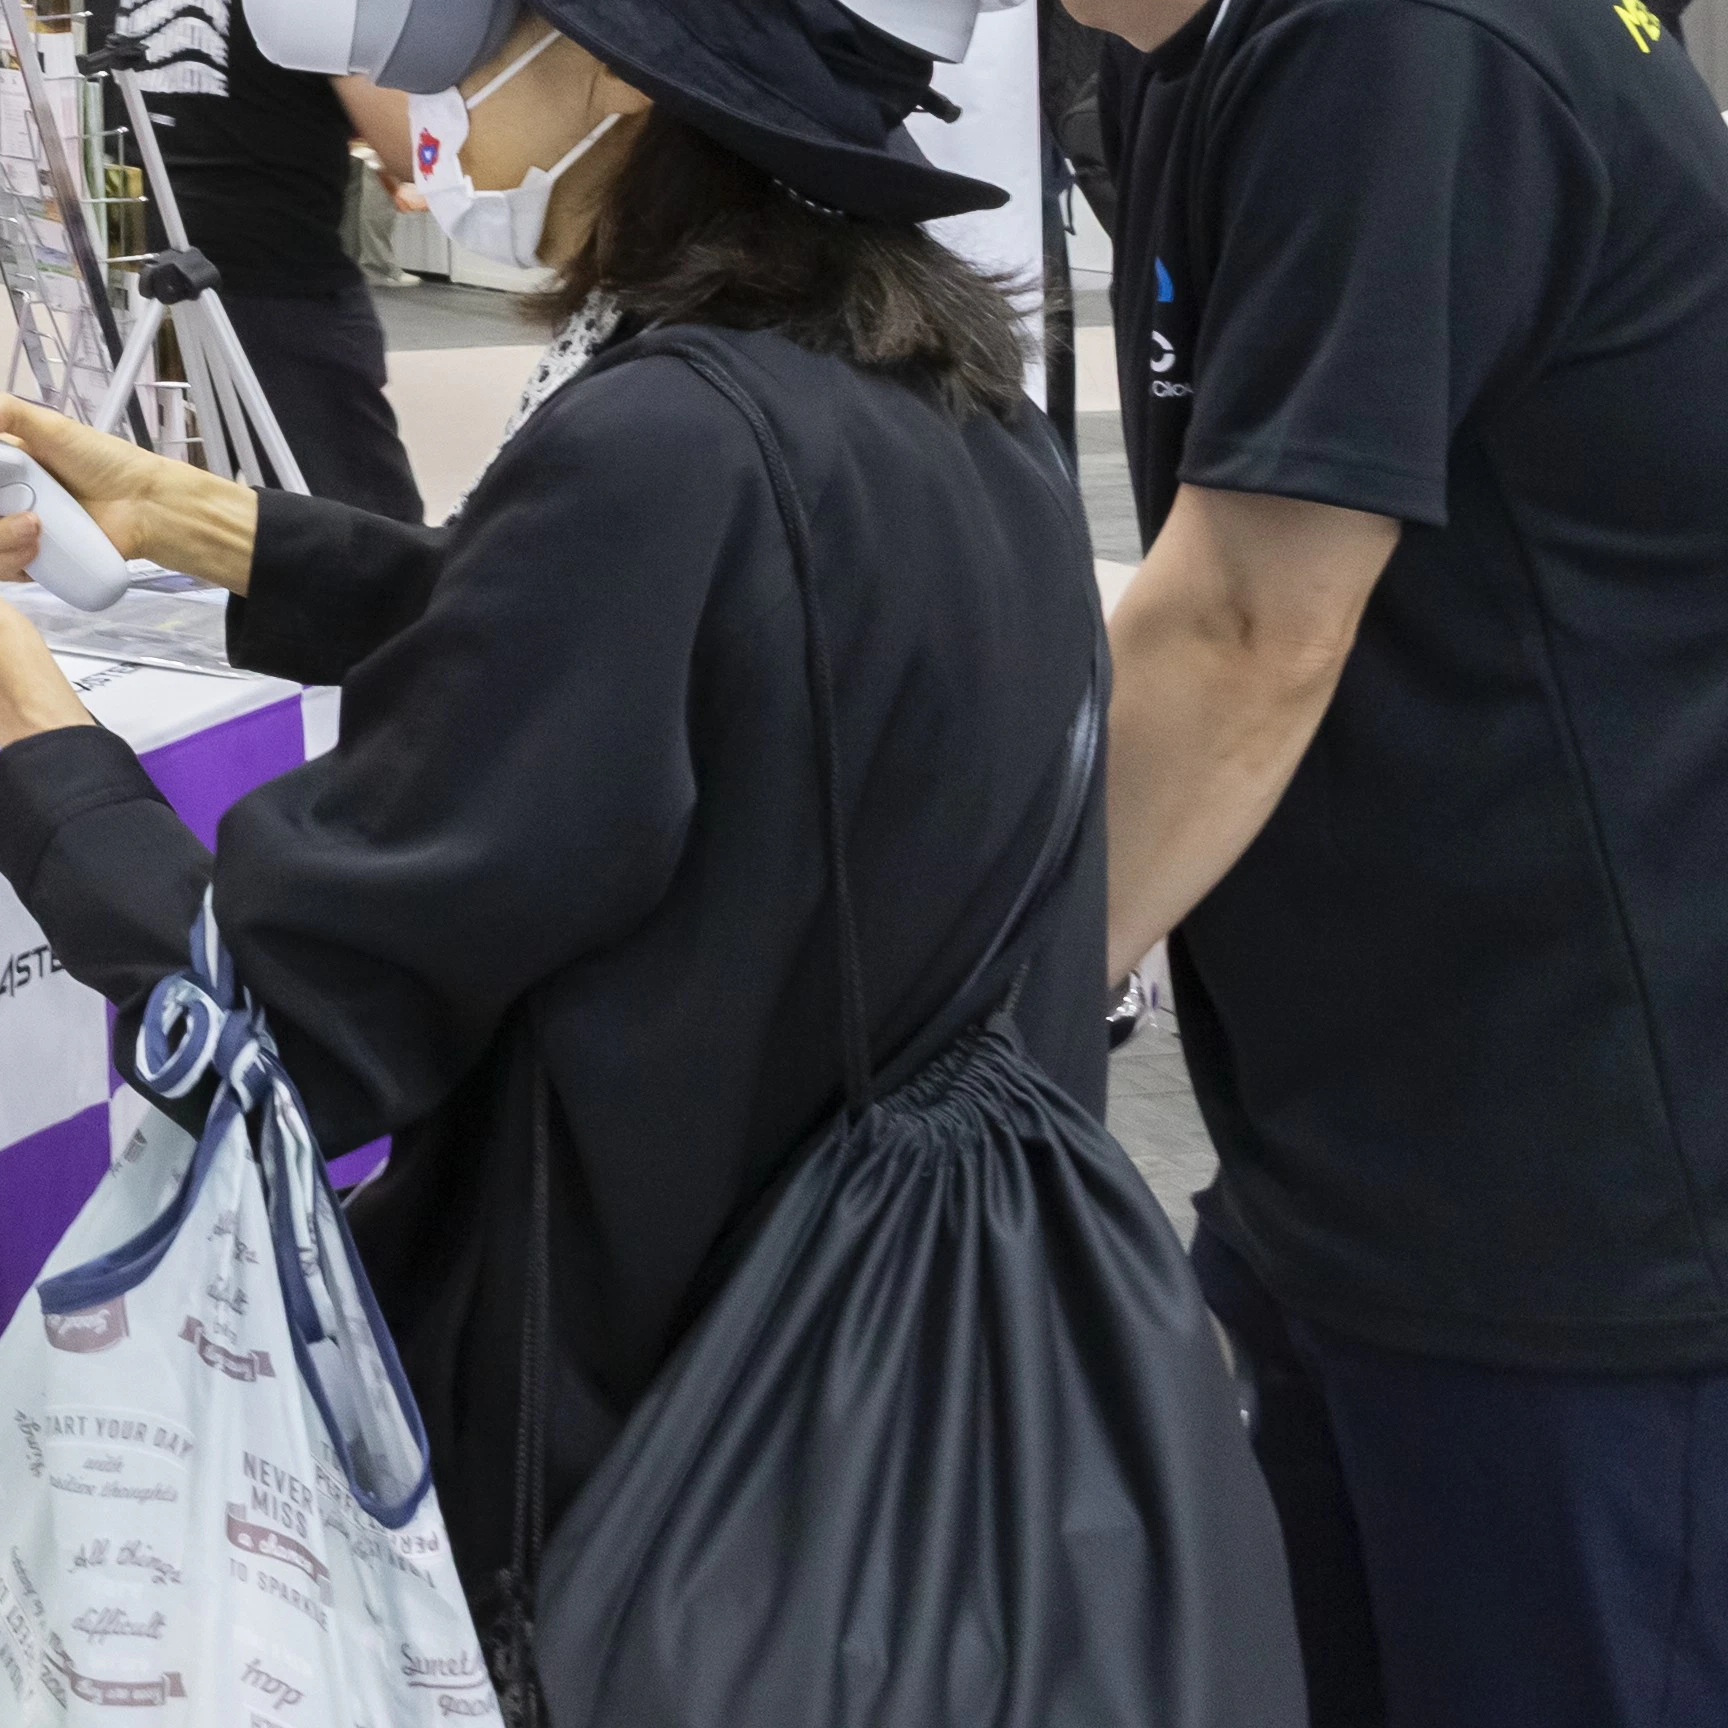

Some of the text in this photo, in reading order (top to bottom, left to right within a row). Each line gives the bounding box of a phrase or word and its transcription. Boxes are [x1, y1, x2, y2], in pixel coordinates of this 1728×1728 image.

[95, 1417, 149, 1442] YOUR
[153, 1427, 194, 1460] DAY
[243, 1451, 313, 1515] NEVER
[251, 1486, 308, 1540] MISS
